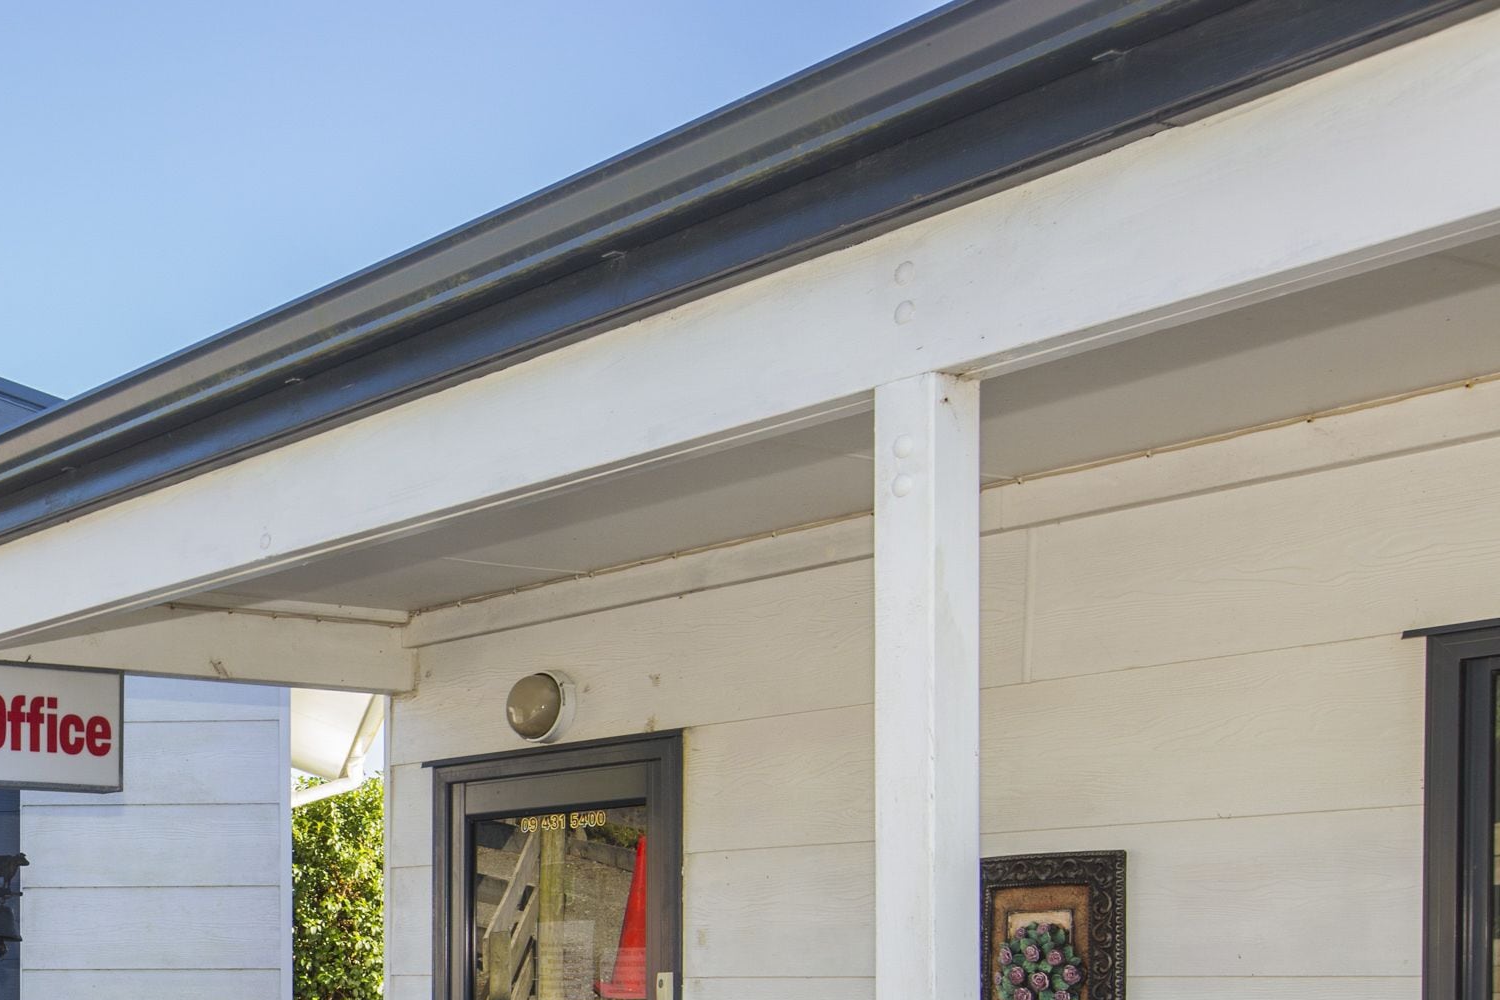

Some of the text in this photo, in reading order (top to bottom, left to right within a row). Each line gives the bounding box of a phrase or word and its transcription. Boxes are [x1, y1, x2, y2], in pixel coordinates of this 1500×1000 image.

[521, 810, 606, 833] 09 431 5400
